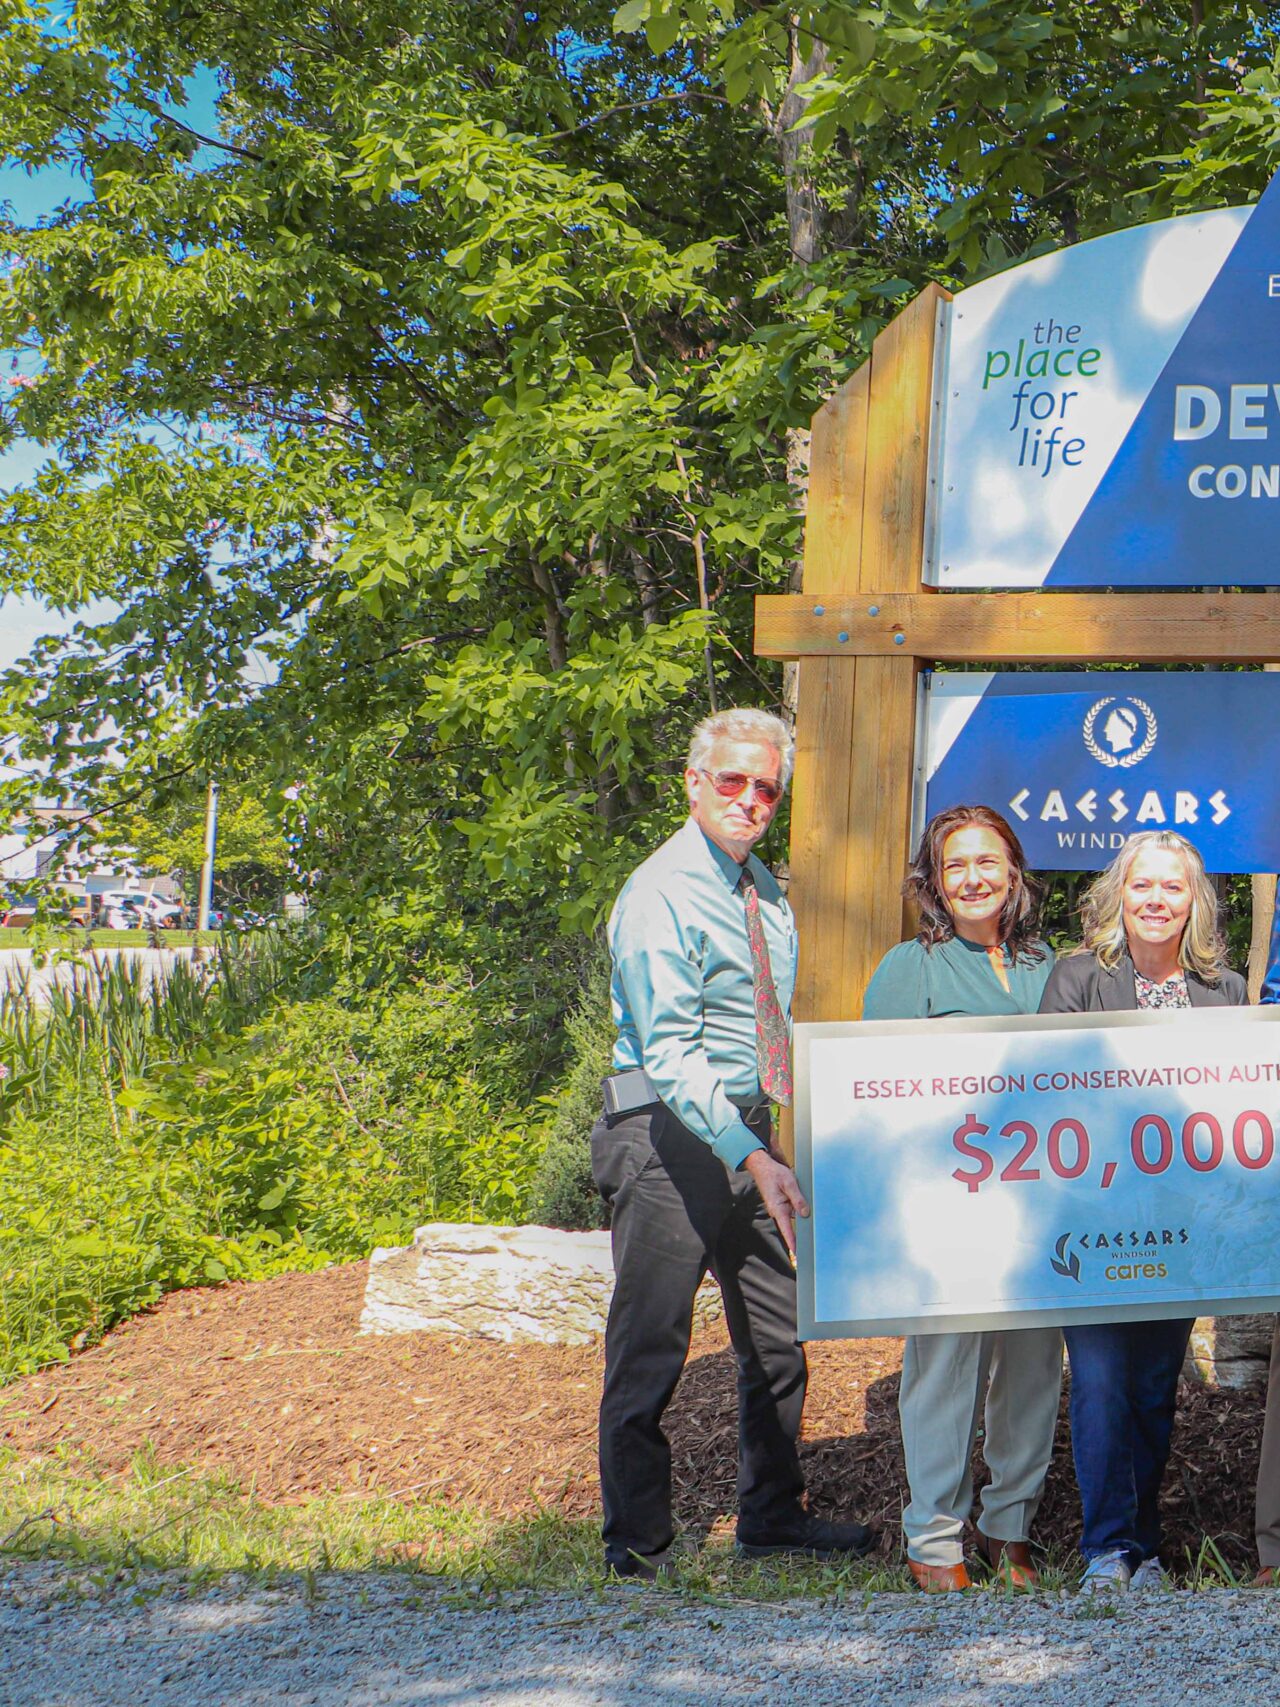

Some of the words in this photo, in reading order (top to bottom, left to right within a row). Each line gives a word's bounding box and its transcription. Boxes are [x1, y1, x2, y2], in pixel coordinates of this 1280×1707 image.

[1033, 318, 1082, 345] the
[982, 338, 1102, 390] place
[1009, 380, 1079, 432] for
[1018, 426, 1086, 478] life
[1008, 788, 1232, 825] CAESARS
[1057, 832, 1131, 850] WIND
[853, 1079, 924, 1100] ESSEX
[932, 1074, 1026, 1097] REGION
[1032, 1065, 1222, 1093] CONSERVATION
[951, 1109, 1275, 1194] $20,000
[1079, 1228, 1190, 1249] CAESARS
[1111, 1250, 1158, 1259] WINDSOR
[1105, 1262, 1168, 1281] cares
